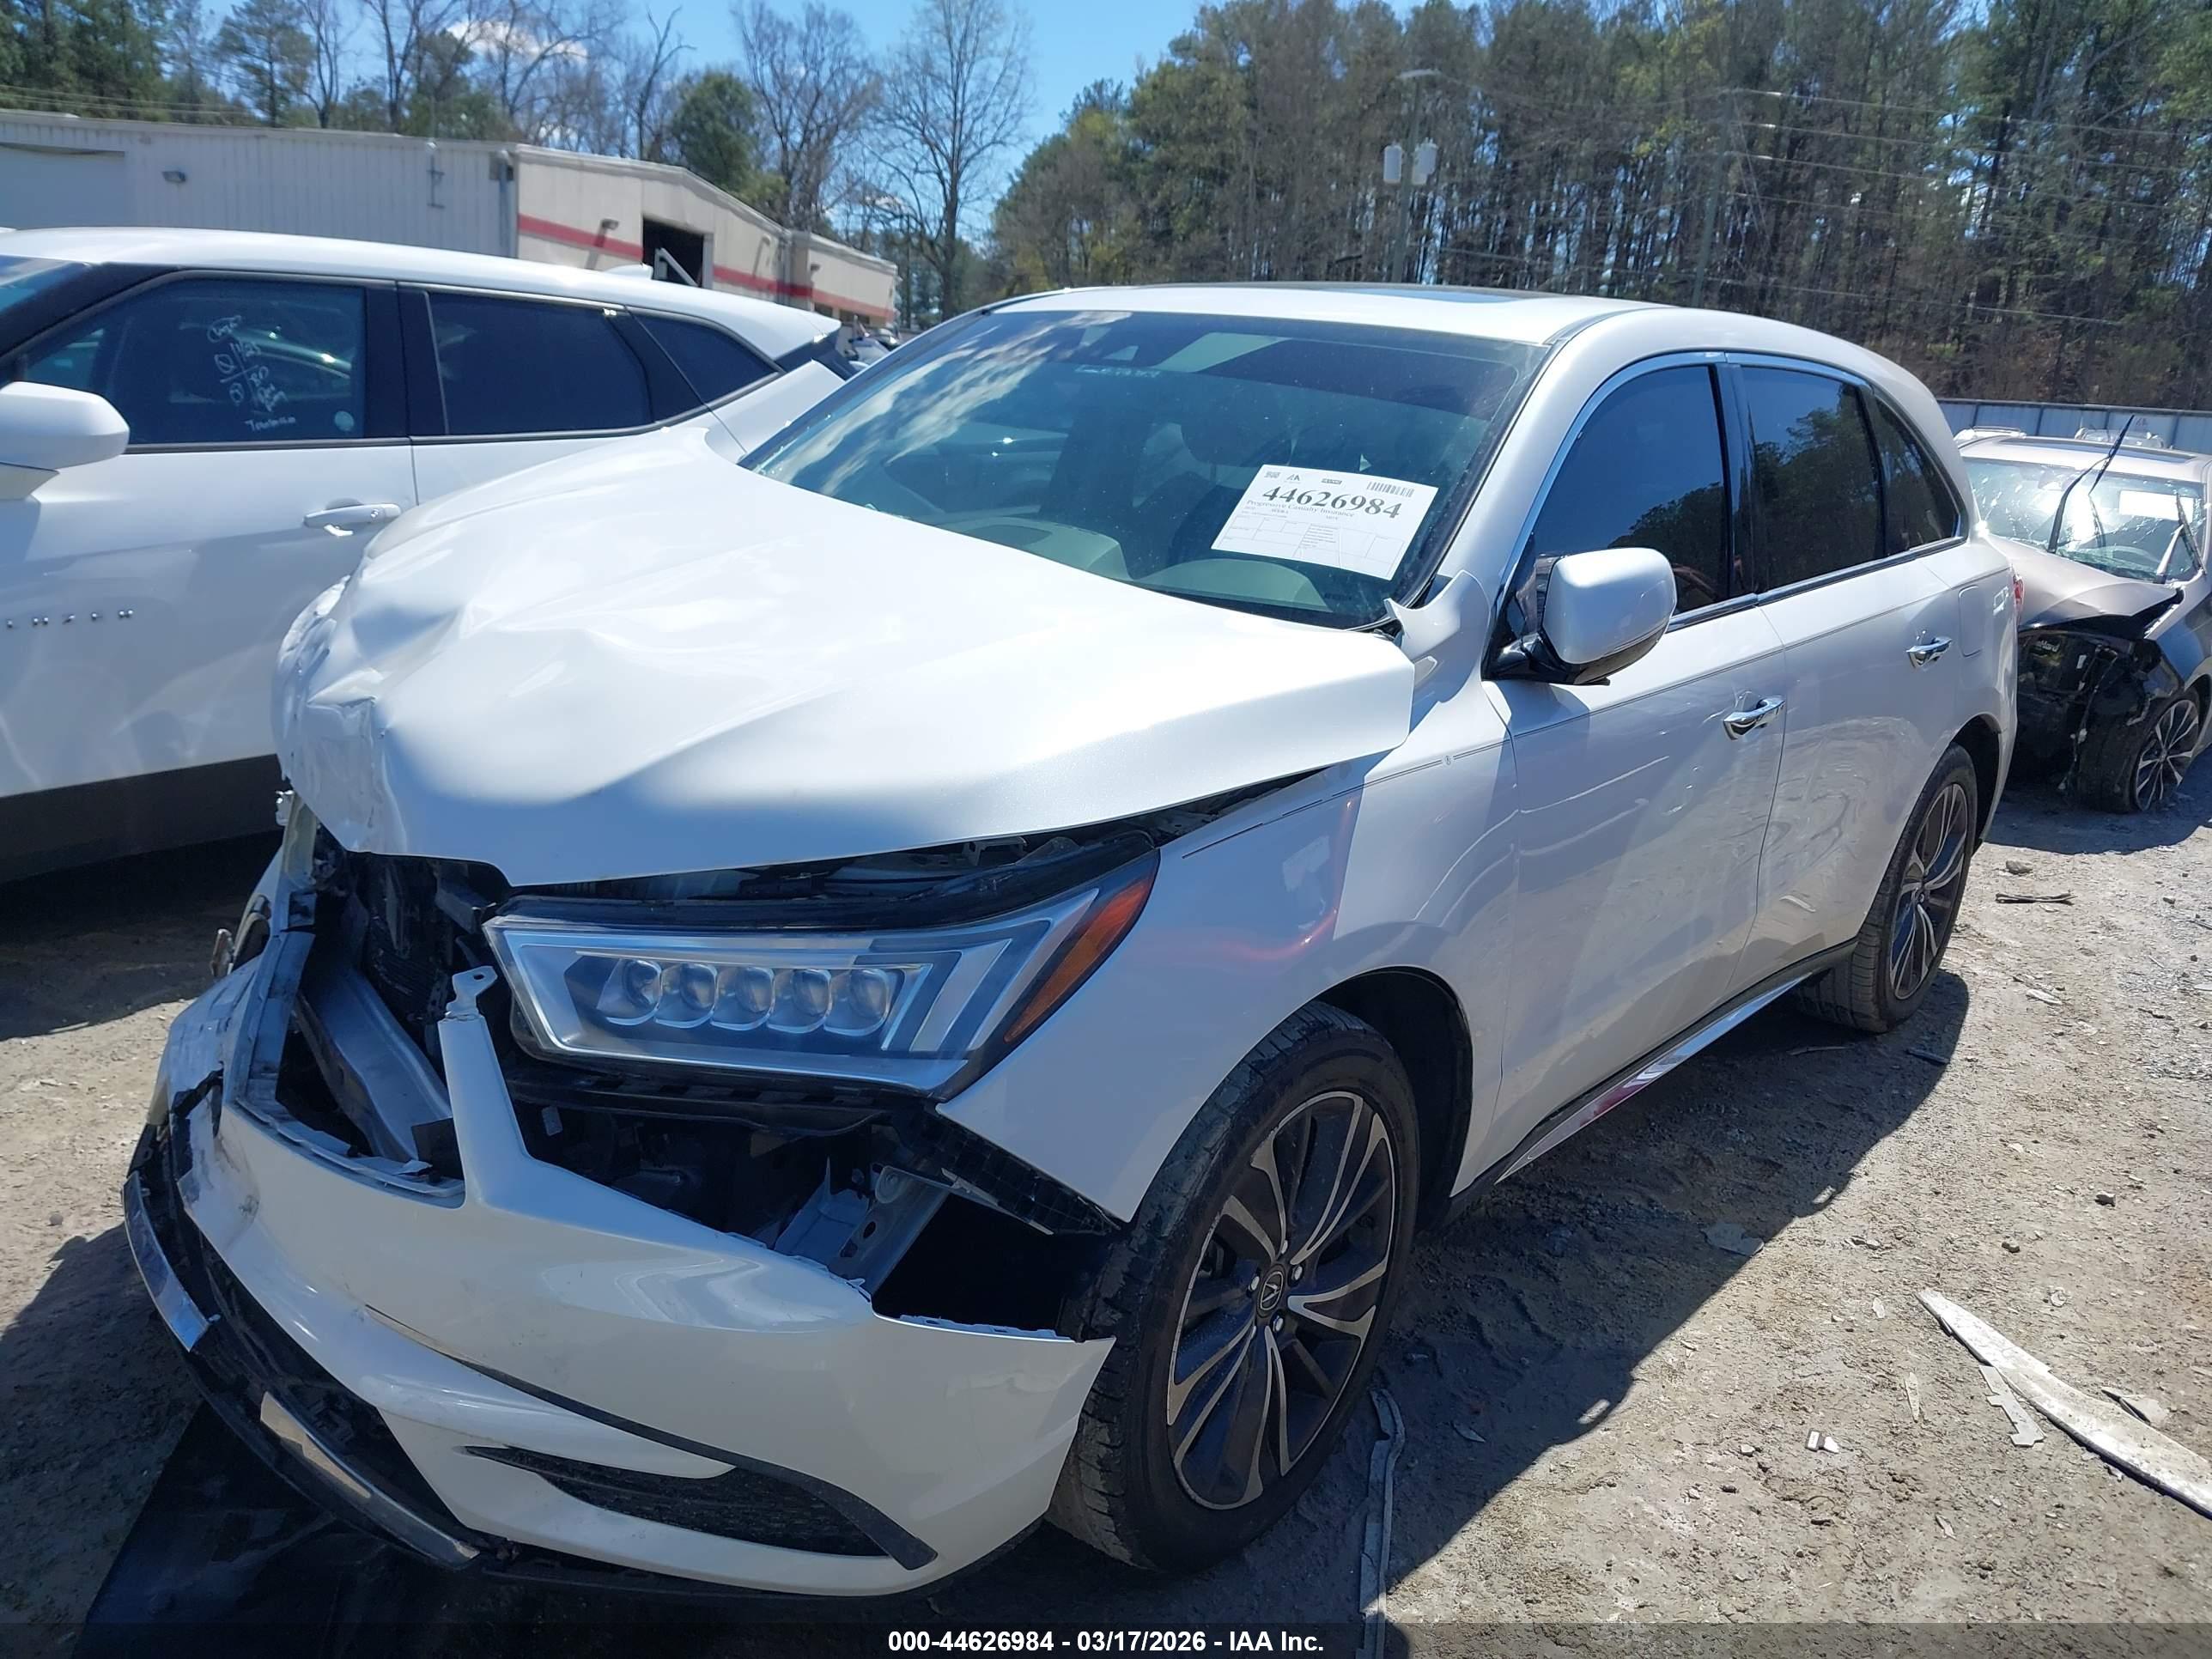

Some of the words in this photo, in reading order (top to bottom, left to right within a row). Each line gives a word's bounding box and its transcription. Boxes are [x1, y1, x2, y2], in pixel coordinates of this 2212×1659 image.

[1246, 500, 1287, 509] Progressive
[1288, 504, 1318, 513] Casualty
[1320, 507, 1355, 518] Insurance
[1262, 486, 1402, 519] 44626984
